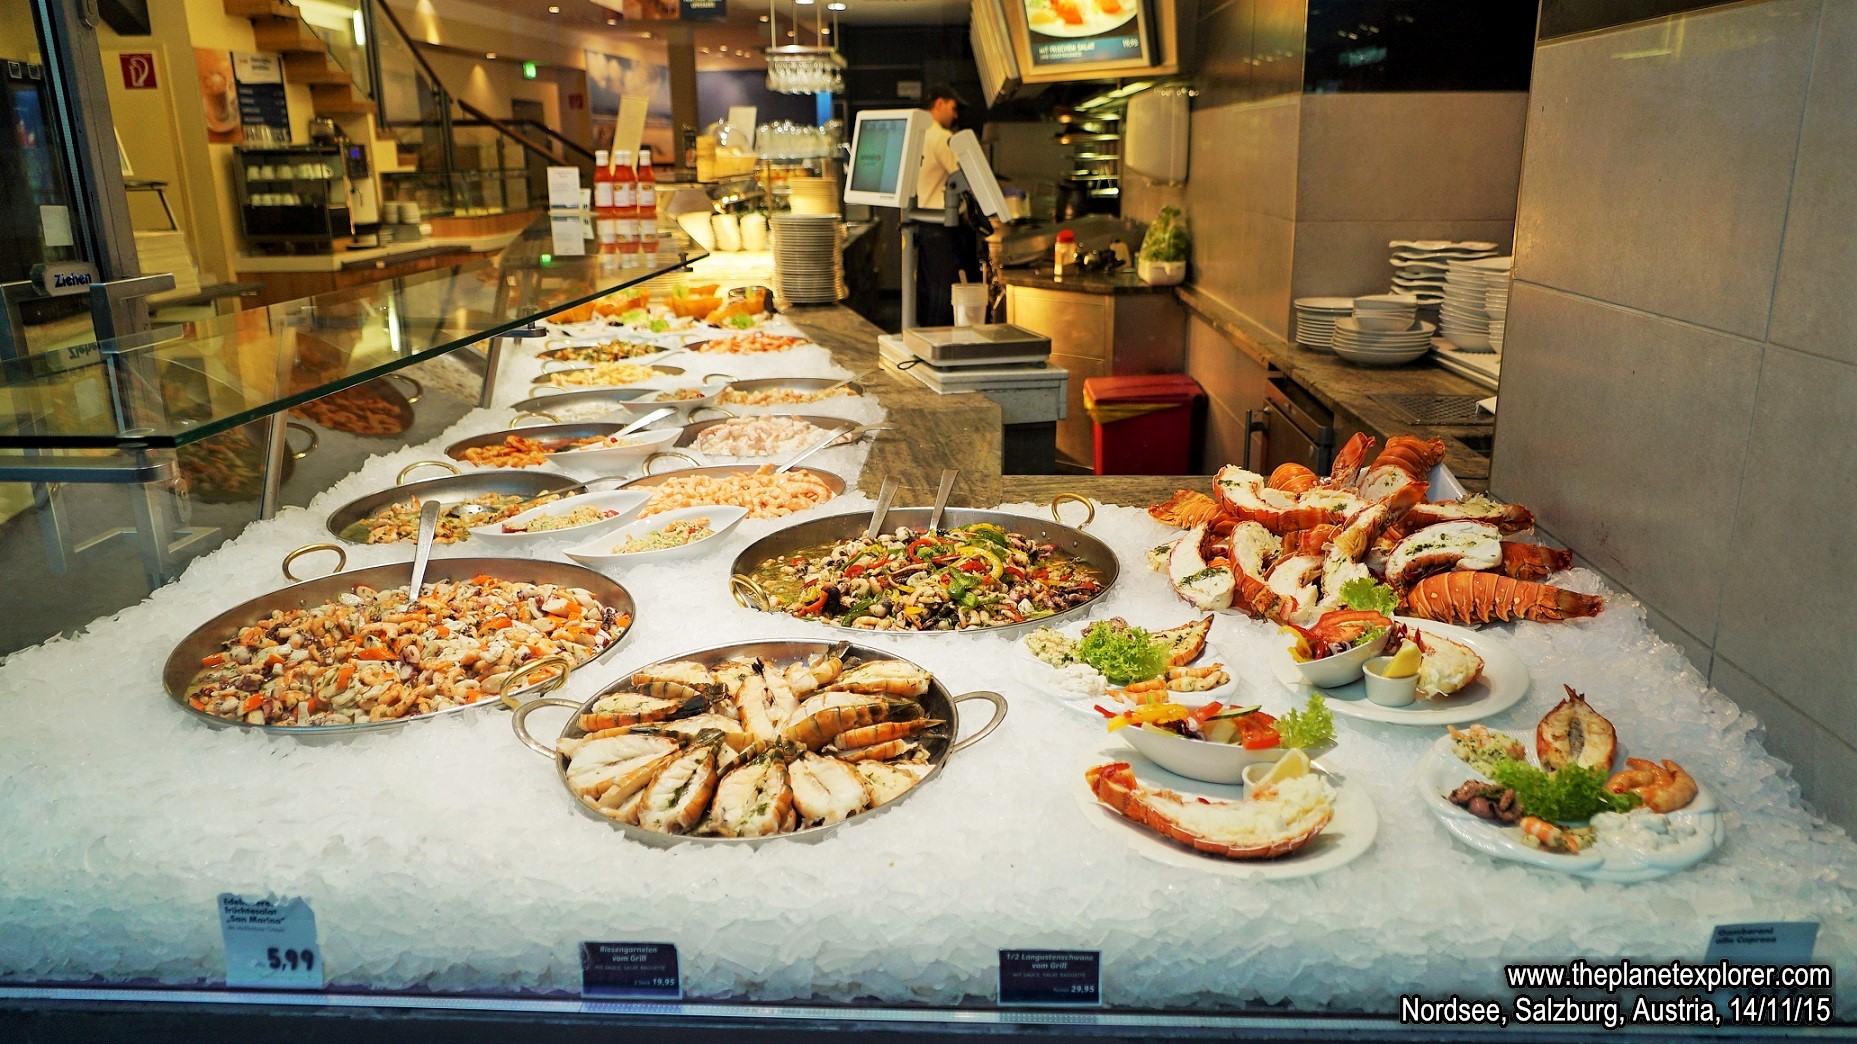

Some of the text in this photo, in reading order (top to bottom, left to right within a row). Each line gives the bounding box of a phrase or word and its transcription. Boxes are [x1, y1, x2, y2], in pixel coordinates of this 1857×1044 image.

[54, 273, 92, 288] Ziehen
[600, 946, 658, 954] Riesengarnelen
[267, 947, 315, 972] 5,99
[629, 954, 647, 963] Grill
[1006, 953, 1094, 962] 1/2 Langustenschwanz
[1050, 962, 1068, 970] Grill
[652, 977, 676, 987] 19,95
[1070, 984, 1096, 995] 29,95
